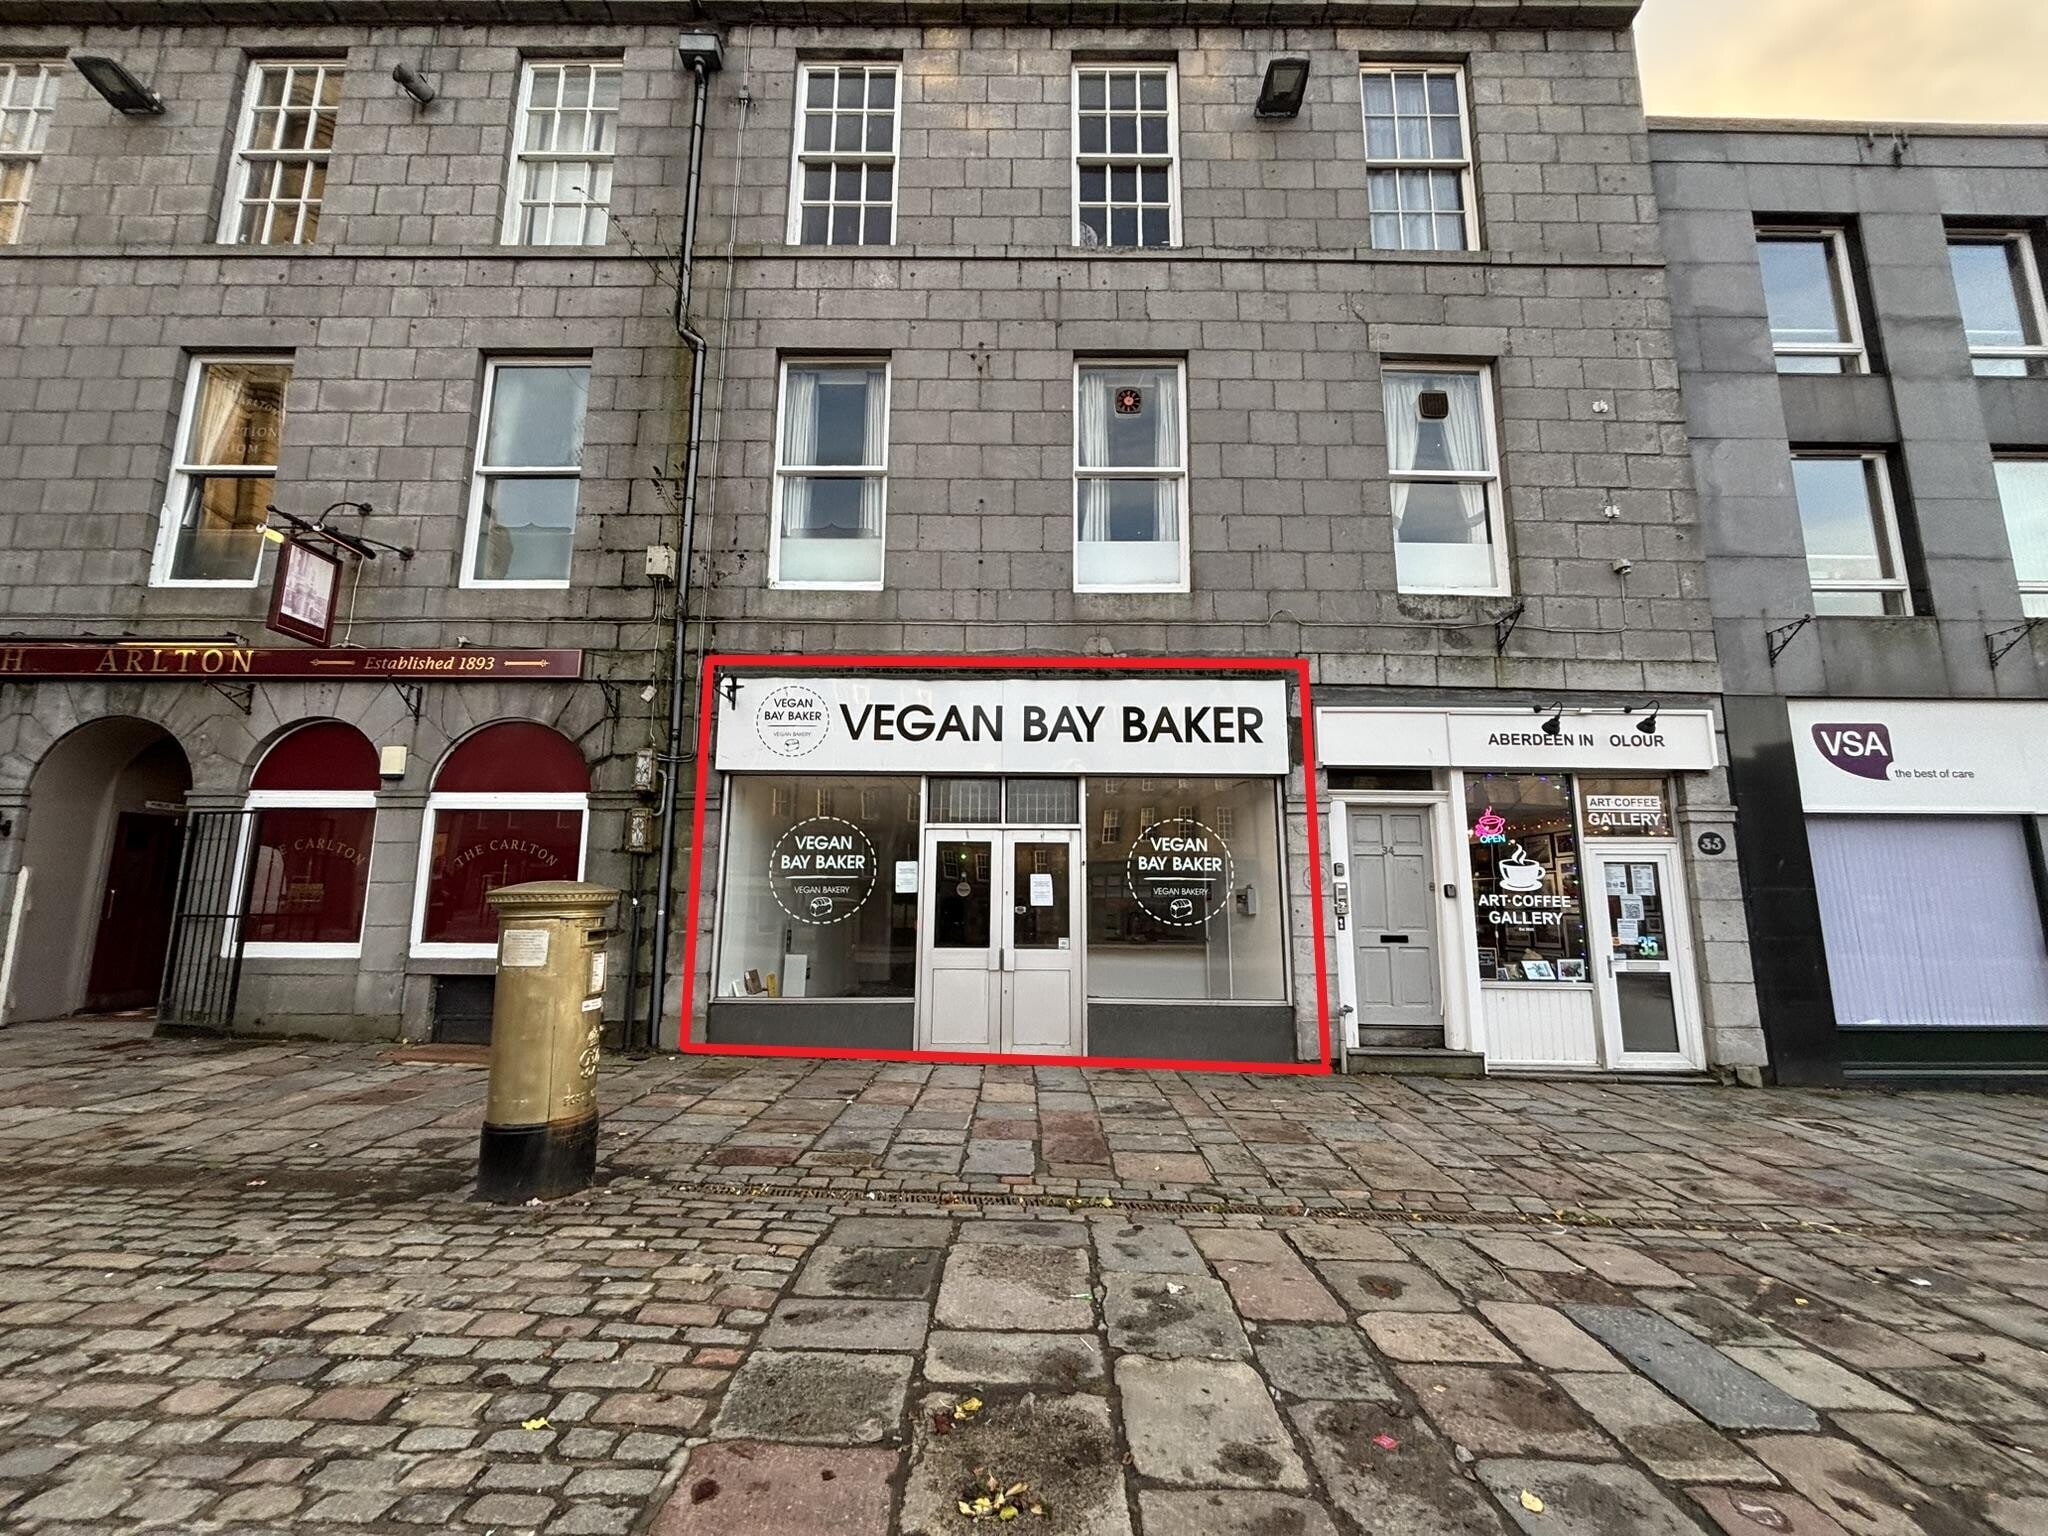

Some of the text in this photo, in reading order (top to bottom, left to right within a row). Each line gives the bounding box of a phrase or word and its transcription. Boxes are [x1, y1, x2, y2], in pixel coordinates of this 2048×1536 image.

[363, 656, 496, 671] Established 1893
[774, 698, 813, 708] VEGAN
[764, 711, 822, 721] BAY BAKER
[839, 703, 1264, 744] VEGAN BAY BAKER
[1488, 733, 1574, 746] ABERDEEN
[1579, 734, 1594, 747] IN
[1819, 730, 1889, 757] VSA
[1895, 768, 1975, 780] the best of care
[1588, 812, 1661, 826] GALLERY
[794, 835, 853, 850] VEGAN
[1150, 837, 1208, 852] VEGAN
[1479, 833, 1506, 844] OPEN
[294, 837, 367, 867] CARLTON
[453, 838, 558, 868] THE CARLTON
[1381, 846, 1396, 856] 34
[780, 854, 866, 870] BAY BAKER
[1138, 856, 1222, 872] BAY BAKER
[794, 885, 850, 894] VEGAN BAKERY
[1152, 887, 1209, 896] VEGAN BAKERY
[1488, 911, 1564, 926] GALLERY
[1638, 936, 1659, 956] 35
